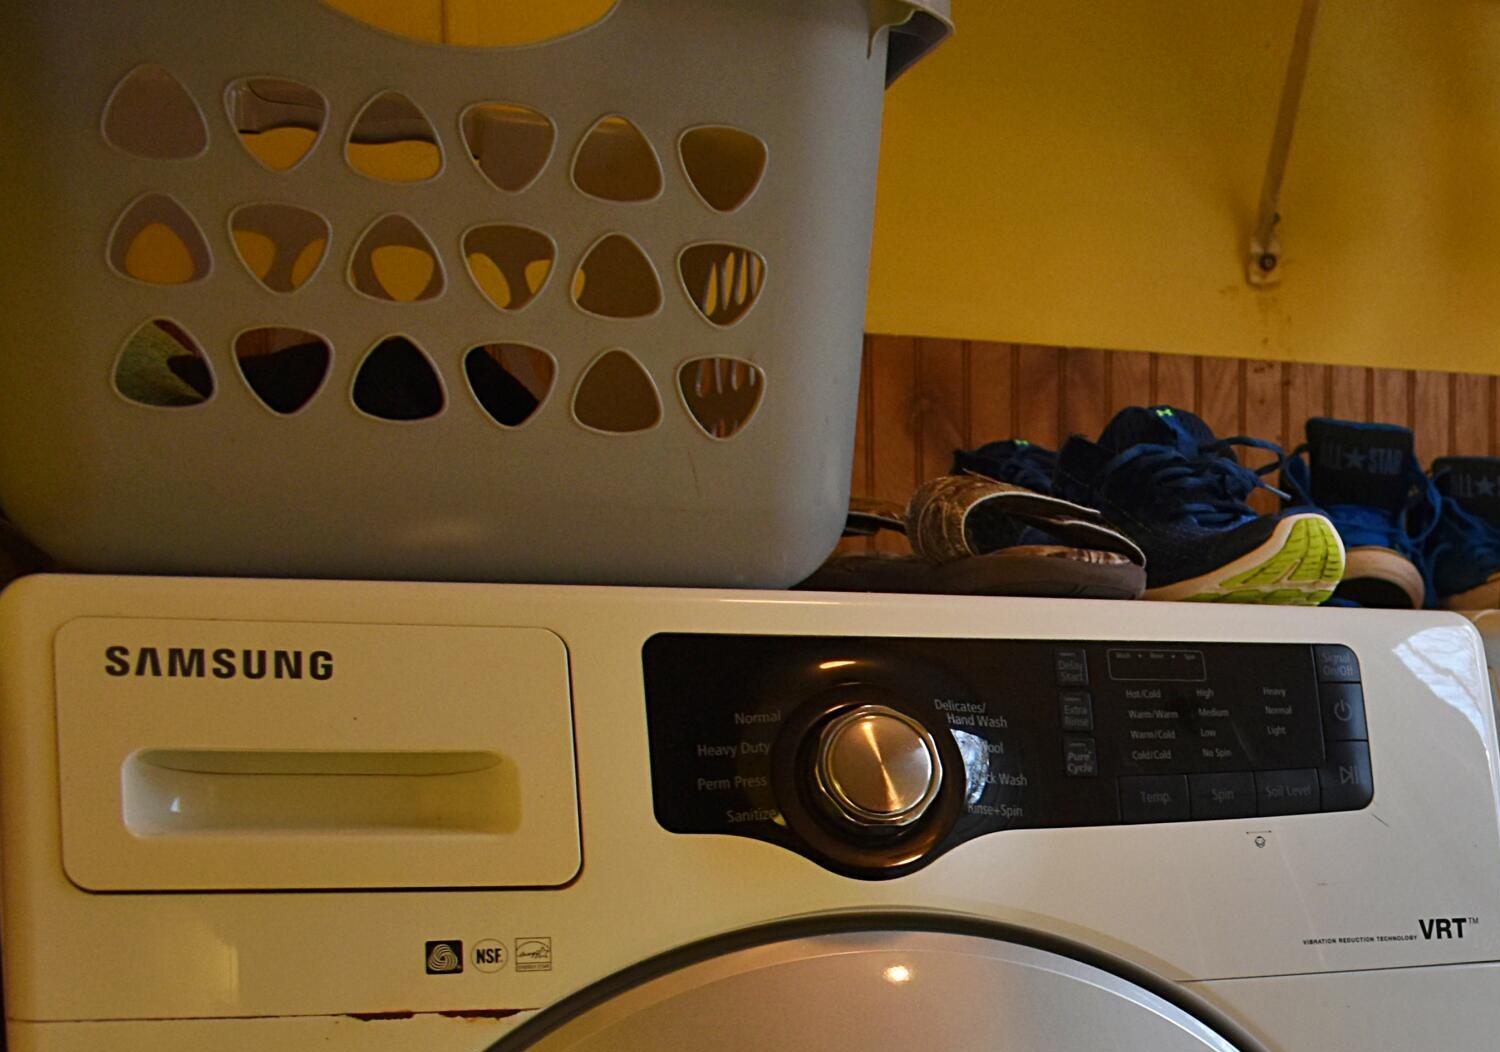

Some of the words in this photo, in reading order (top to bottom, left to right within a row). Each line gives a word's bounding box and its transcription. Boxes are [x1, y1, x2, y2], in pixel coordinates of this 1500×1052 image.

[104, 646, 335, 681] SAMSUNG
[934, 698, 987, 713] Delicates/
[734, 708, 782, 725] Normal
[946, 711, 975, 727] Hand
[976, 714, 1009, 729] Wash
[696, 743, 738, 760] Heavy
[740, 741, 770, 756] Duty
[696, 777, 732, 791] Perm
[733, 775, 768, 789] Press
[998, 771, 1028, 787] Wash
[1140, 791, 1171, 806] Temp
[1211, 788, 1235, 804] Spin
[726, 808, 778, 824] Sanitize
[1302, 937, 1337, 946] VIBRATION
[1338, 936, 1375, 944] REDUCTION
[1376, 935, 1417, 943] TECHNOLOGY
[476, 948, 502, 964] NSF
